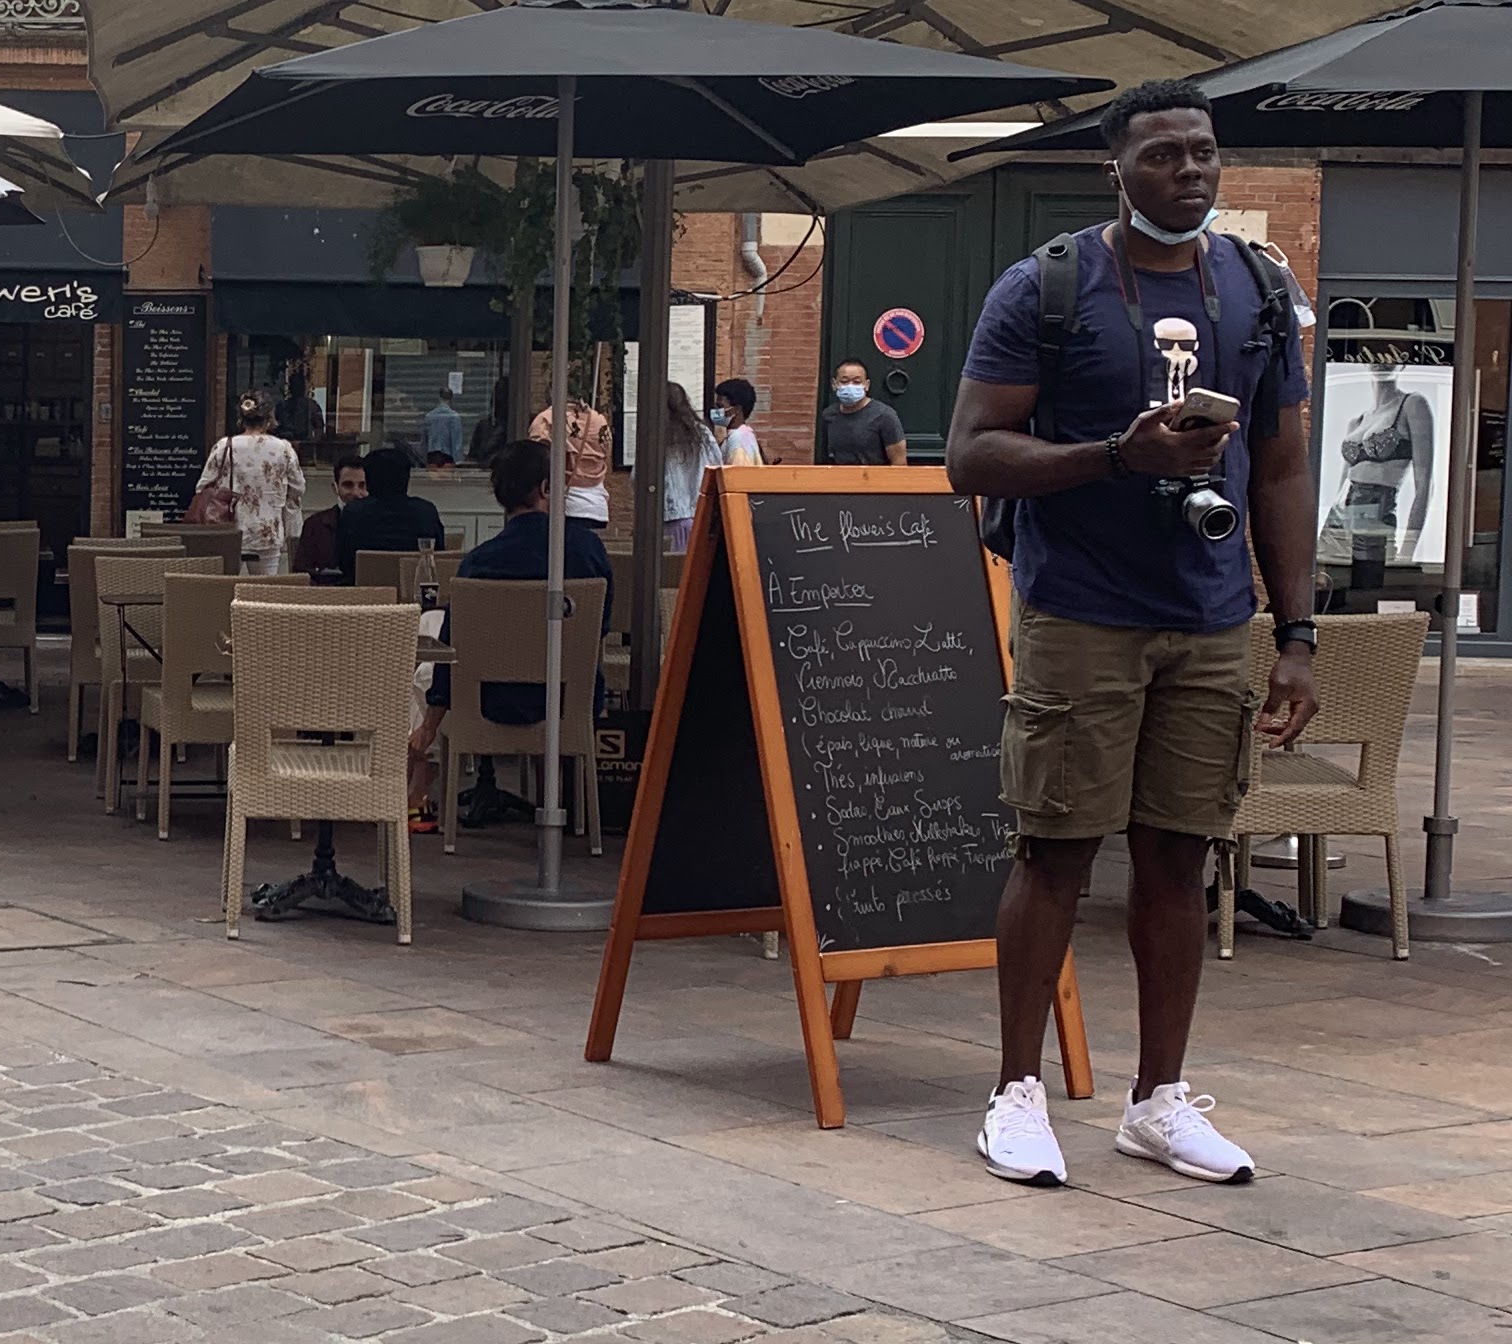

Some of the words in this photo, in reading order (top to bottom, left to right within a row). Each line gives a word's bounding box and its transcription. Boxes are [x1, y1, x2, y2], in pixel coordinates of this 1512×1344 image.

[44, 303, 98, 320] café
[781, 508, 829, 542] The
[767, 557, 784, 605] À
[788, 576, 874, 609] Emporter
[798, 696, 872, 726] Chocolat
